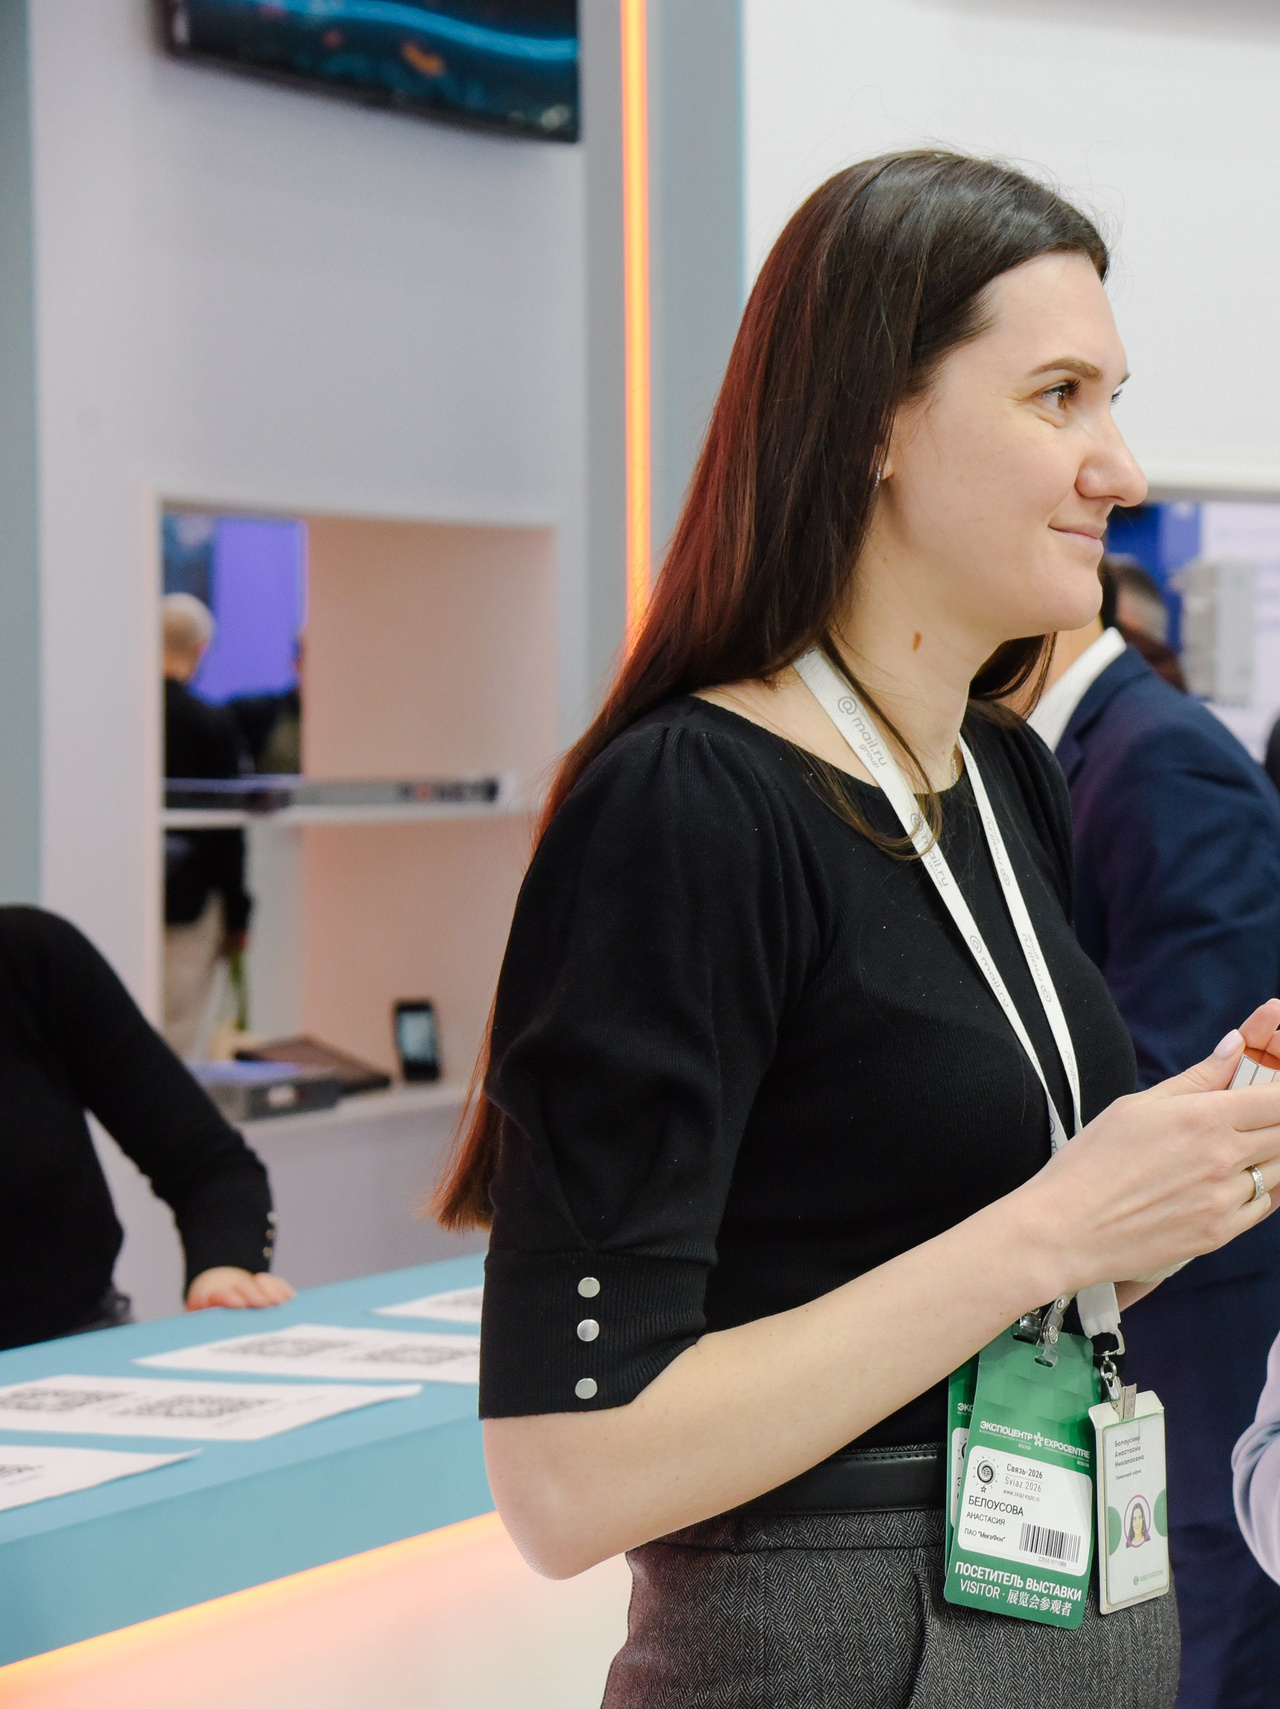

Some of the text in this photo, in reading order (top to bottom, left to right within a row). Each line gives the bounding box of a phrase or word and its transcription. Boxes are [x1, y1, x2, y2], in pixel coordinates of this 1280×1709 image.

[858, 742, 881, 769] group
[980, 1420, 1033, 1441] ЭКСПОЦЕНТР
[1044, 1438, 1090, 1459] EXPOCENTRE
[1006, 1463, 1043, 1479] Связь-2026
[1004, 1476, 1042, 1492] Sviaz 2026
[968, 1495, 1024, 1516] БЕЛОУСОВА
[966, 1511, 1006, 1526] АНАСТАСИЯ
[964, 1528, 977, 1537] ПАО
[955, 1561, 1082, 1602] ПОСЕТИТЕЛЬ ВЫСТАВКИ
[960, 1578, 1073, 1617] VISITOR 展览会参观者
